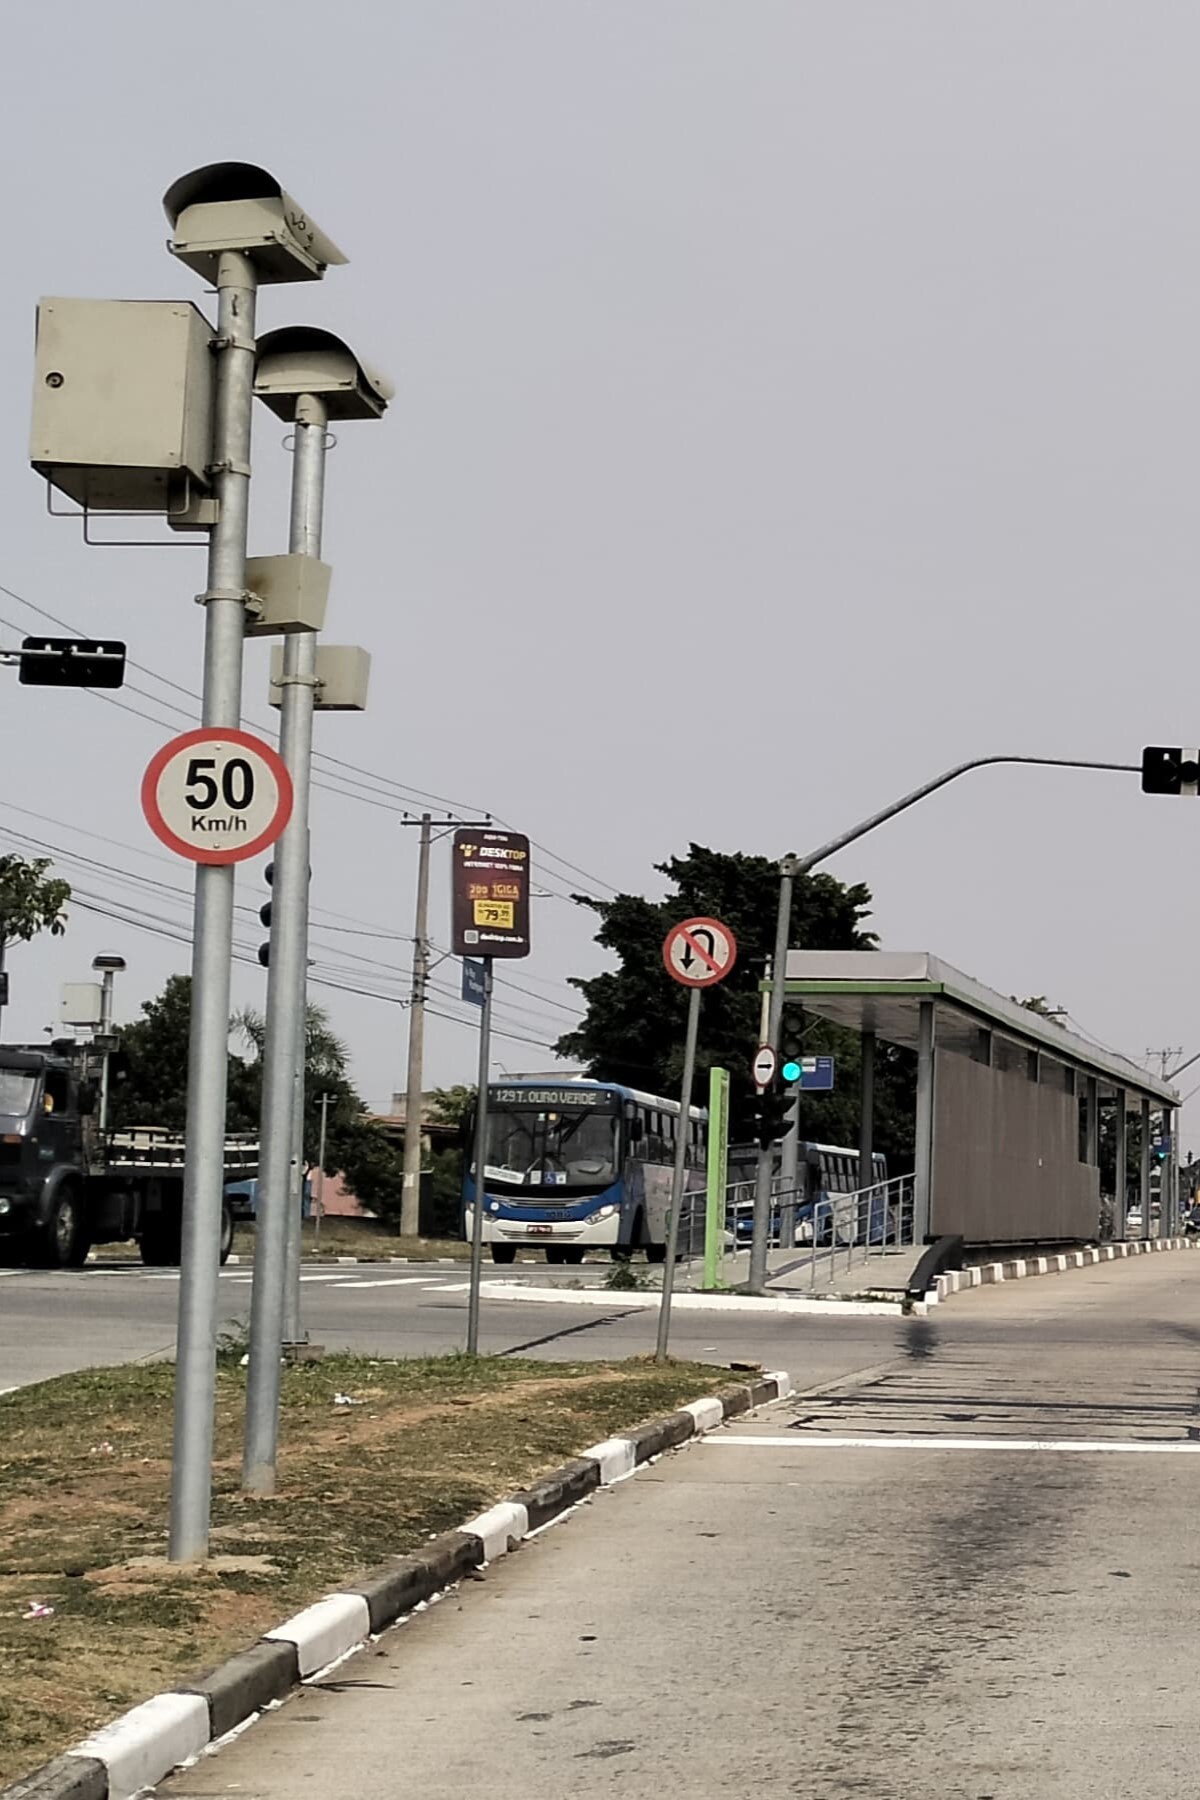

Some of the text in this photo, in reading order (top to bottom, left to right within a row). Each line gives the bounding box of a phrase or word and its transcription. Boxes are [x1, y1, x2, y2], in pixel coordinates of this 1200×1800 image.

[184, 758, 254, 810] 50
[191, 815, 247, 832] Km/h
[479, 846, 527, 860] DESKTOP
[496, 1090, 515, 1102] 129
[528, 1091, 558, 1104] OURO
[559, 1092, 597, 1105] VERDE
